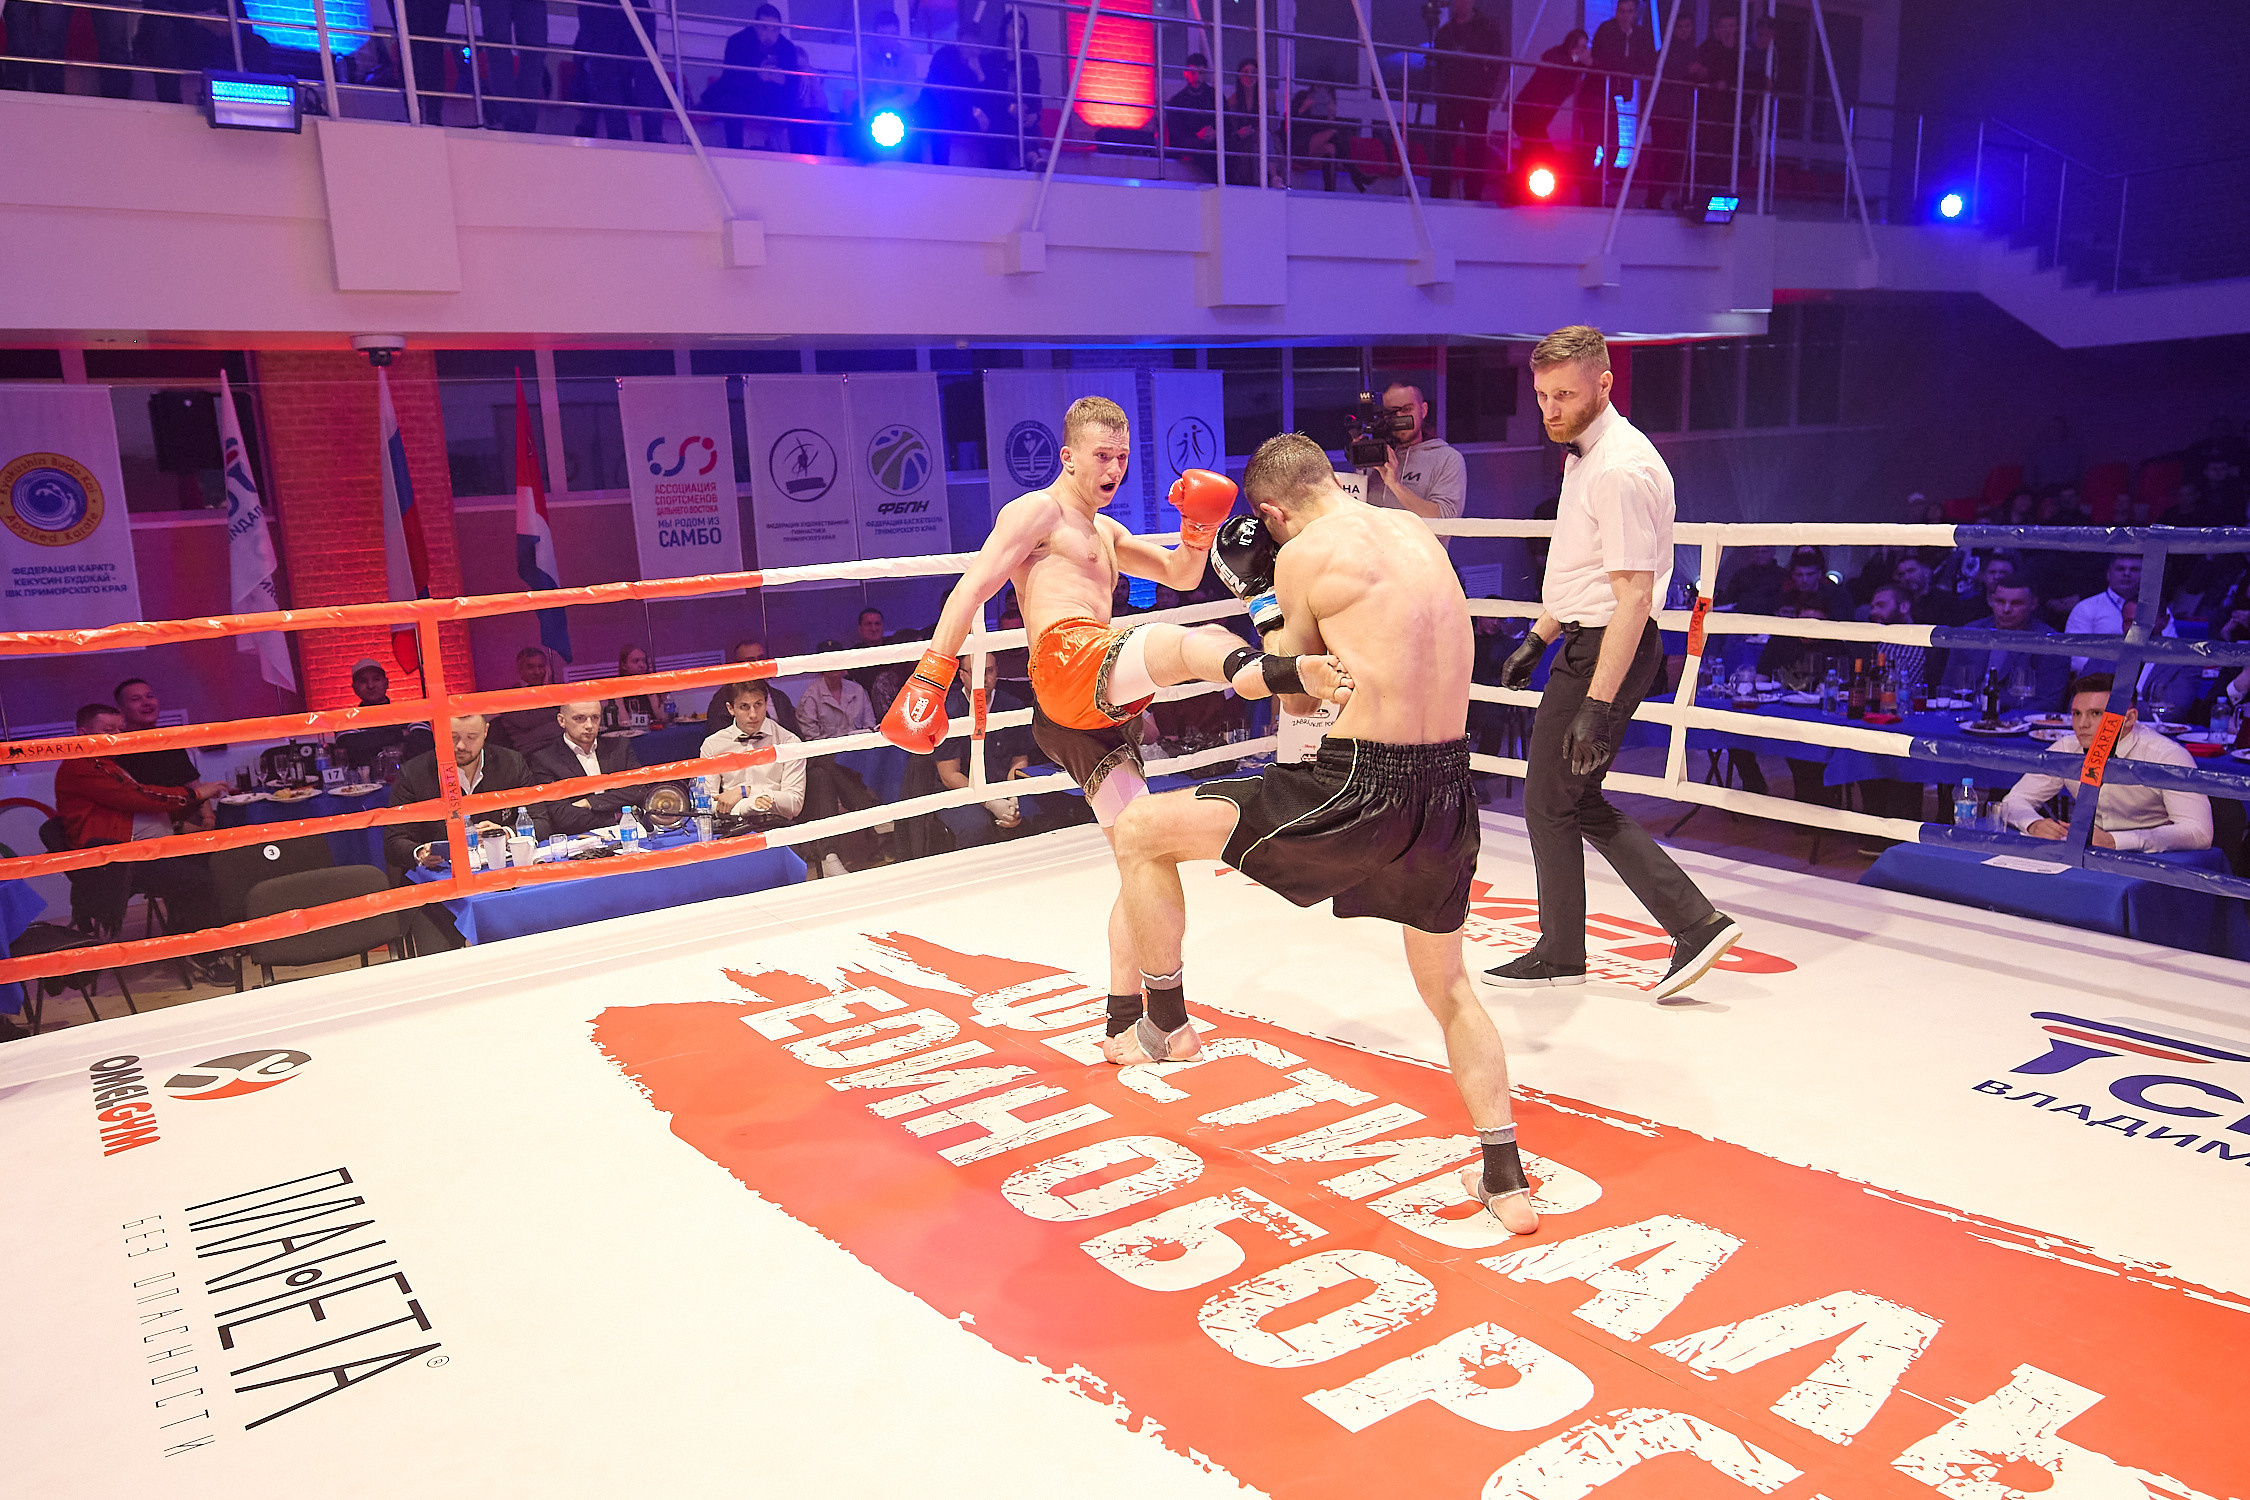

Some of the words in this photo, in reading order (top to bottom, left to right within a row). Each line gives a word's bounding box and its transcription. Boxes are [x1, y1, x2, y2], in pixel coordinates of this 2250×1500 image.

[655, 482, 717, 494] АССОЦИАЦИЯ
[655, 494, 718, 506] СПОРТСМЕНОВ
[689, 505, 719, 514] ВОСТОКА
[878, 500, 929, 514] ФБПН
[658, 519, 673, 528] МЫ
[674, 517, 706, 528] РОДОМ
[707, 516, 720, 526] ИЗ
[659, 527, 722, 548] САМБО
[11, 564, 77, 576] ФЕДЕРАЦИЯ
[78, 563, 115, 573] КАРАТЭ
[13, 576, 62, 586] КЕКУСИН
[64, 573, 111, 584] БУДОКАЙ
[24, 586, 100, 597] ПРИМОРСКОГО
[102, 584, 127, 592] КРАЯ
[1690, 614, 1701, 652] SPARTA
[976, 691, 985, 726] SPARTA
[635, 716, 645, 724] 18
[2090, 719, 2118, 765] SPARTA
[27, 743, 84, 756] SPARTA
[327, 770, 340, 780] 17
[446, 766, 459, 808] SPARTA
[268, 848, 275, 856] 3
[89, 1055, 161, 1158] OMELGYM
[122, 1214, 168, 1258] БЕЗ
[740, 985, 1830, 1500] ЕДИНОБОРС
[133, 1270, 216, 1459] ОПАСНОСТИ
